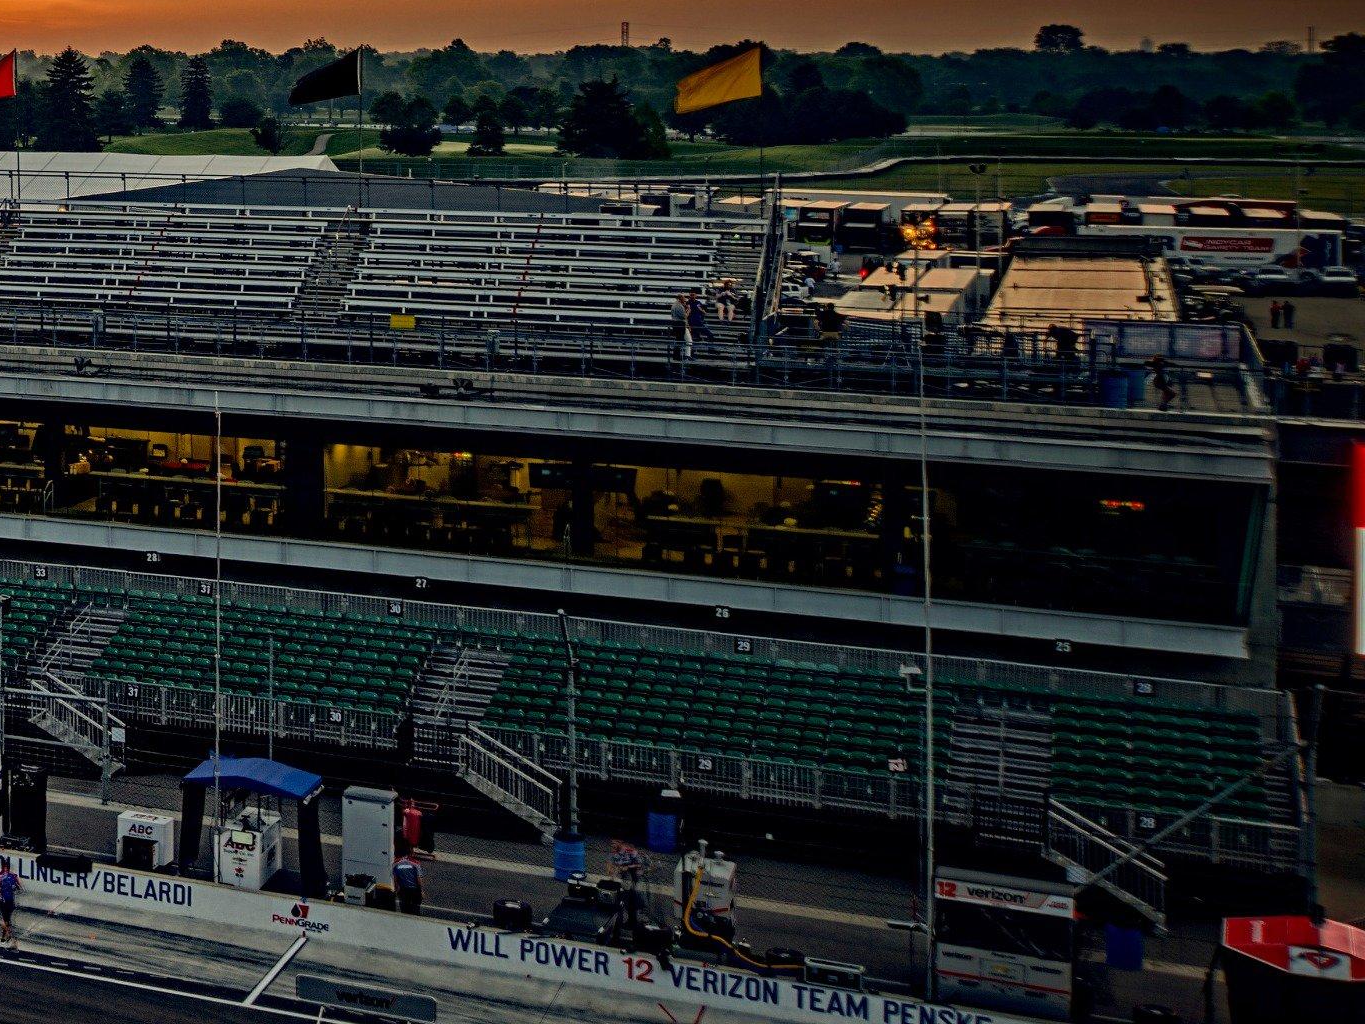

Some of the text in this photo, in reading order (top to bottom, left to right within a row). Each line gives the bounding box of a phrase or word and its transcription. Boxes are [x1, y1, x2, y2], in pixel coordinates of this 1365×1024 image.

[415, 578, 427, 588] 27
[715, 607, 729, 618] 26
[128, 824, 153, 835] ABC
[938, 882, 1026, 904] 12 verizon
[448, 927, 508, 959] WILL
[519, 938, 609, 976] POWER
[622, 957, 655, 984] 12
[668, 964, 778, 1005] VERIZON
[792, 985, 868, 1021] TEAM
